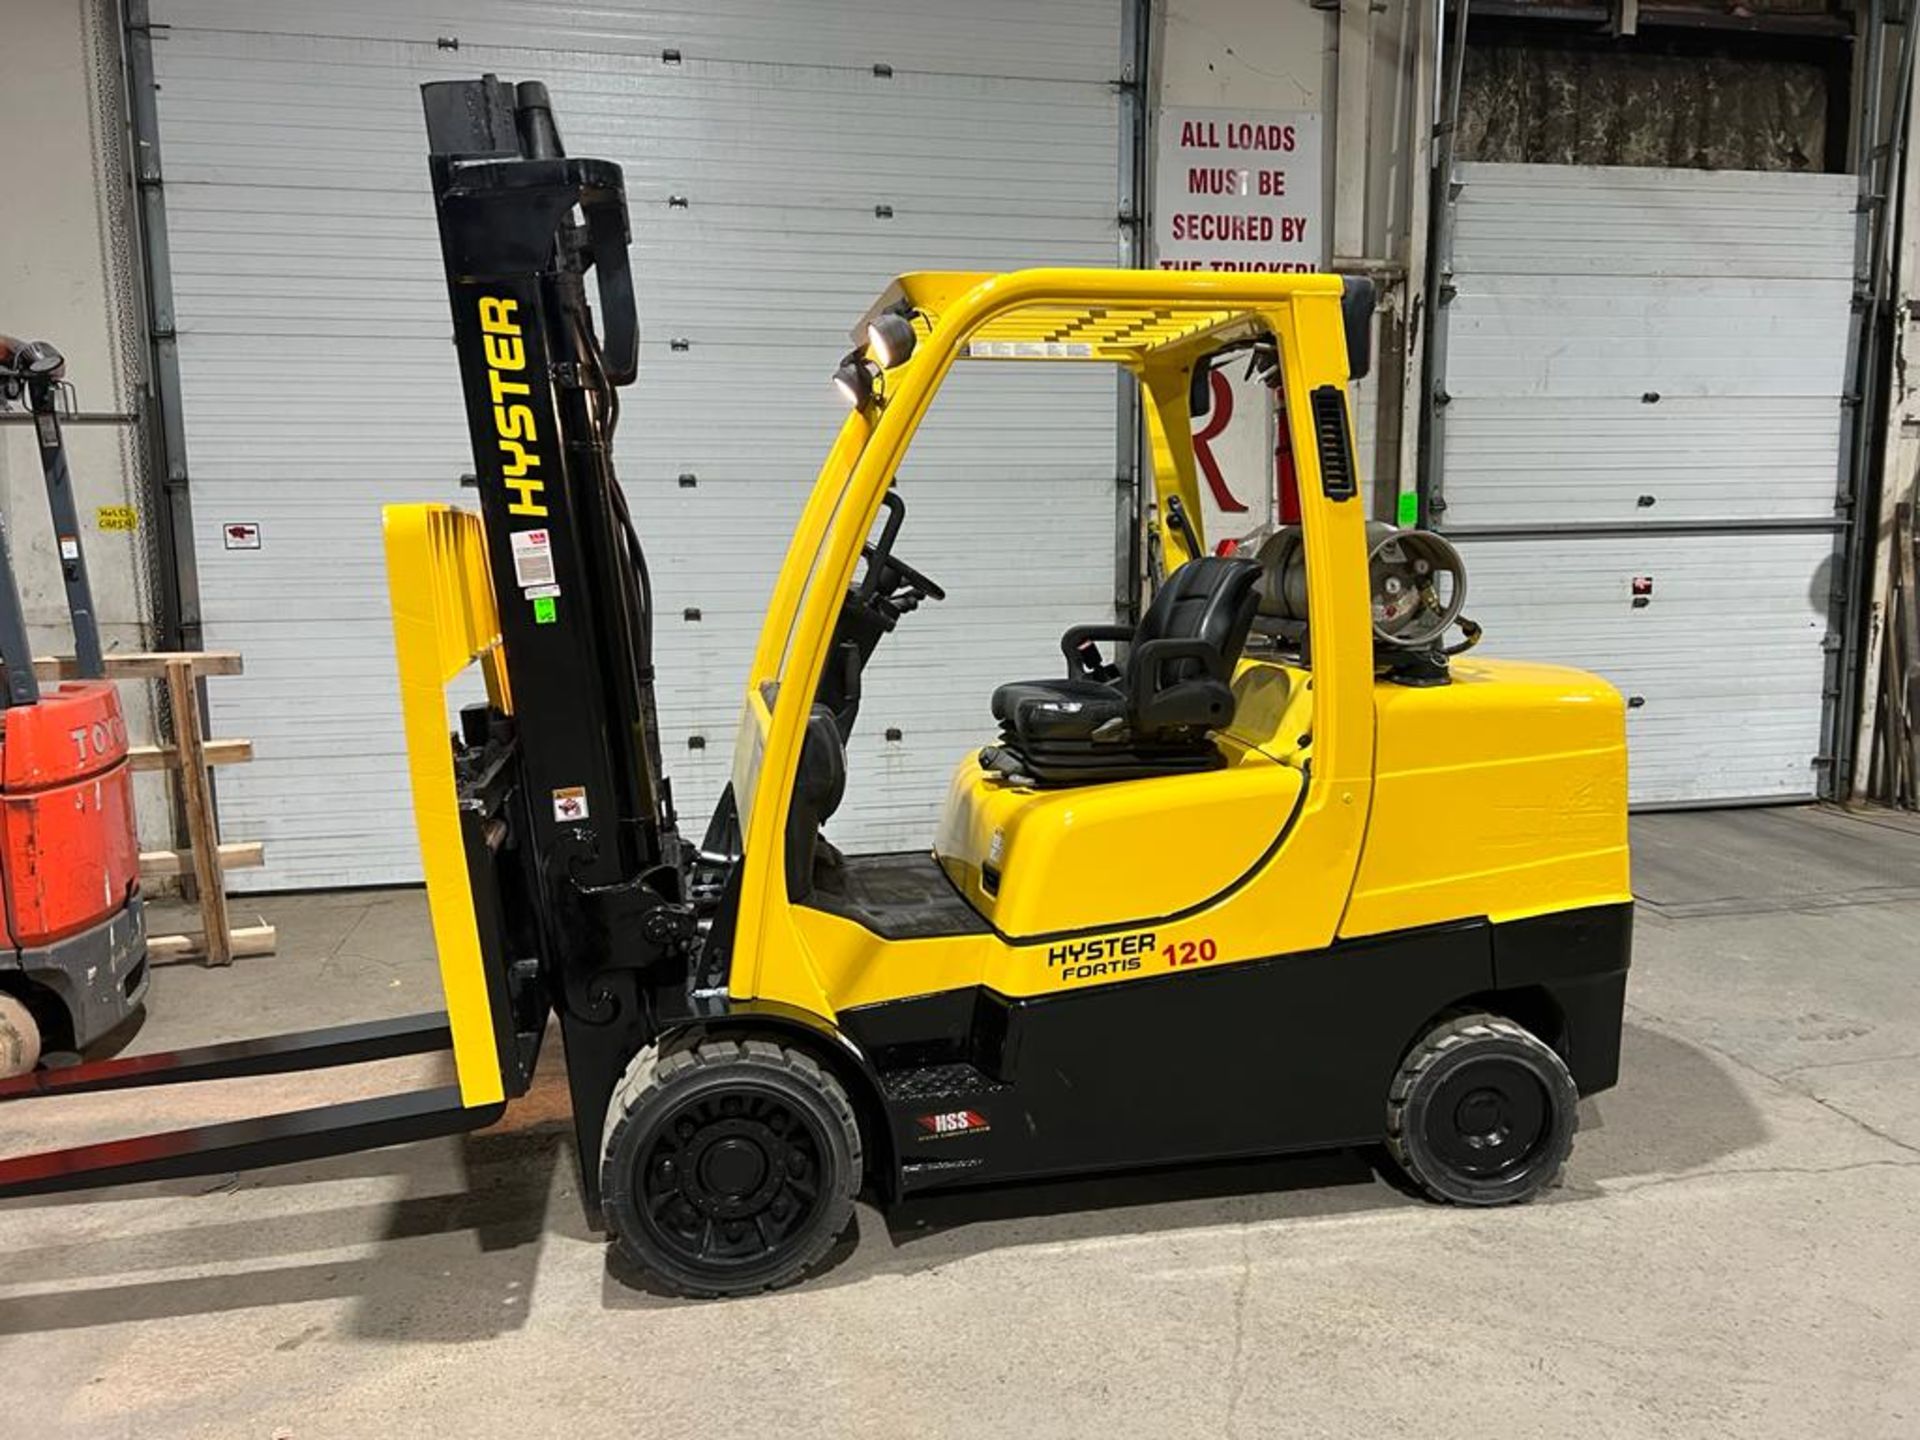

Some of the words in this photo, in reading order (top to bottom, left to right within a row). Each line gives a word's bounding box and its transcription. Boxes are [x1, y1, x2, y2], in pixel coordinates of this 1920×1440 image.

[1180, 121, 1220, 148] ALL
[1227, 123, 1296, 152] LOADS
[1258, 170, 1286, 196] BE
[1172, 213, 1274, 241] SECURED
[1281, 216, 1307, 243] BY
[478, 296, 549, 517] HYSTER
[1048, 932, 1156, 968] HYSTER
[1162, 938, 1218, 967] 120
[1062, 956, 1142, 982] FORTIS
[934, 1110, 969, 1133] HSS
